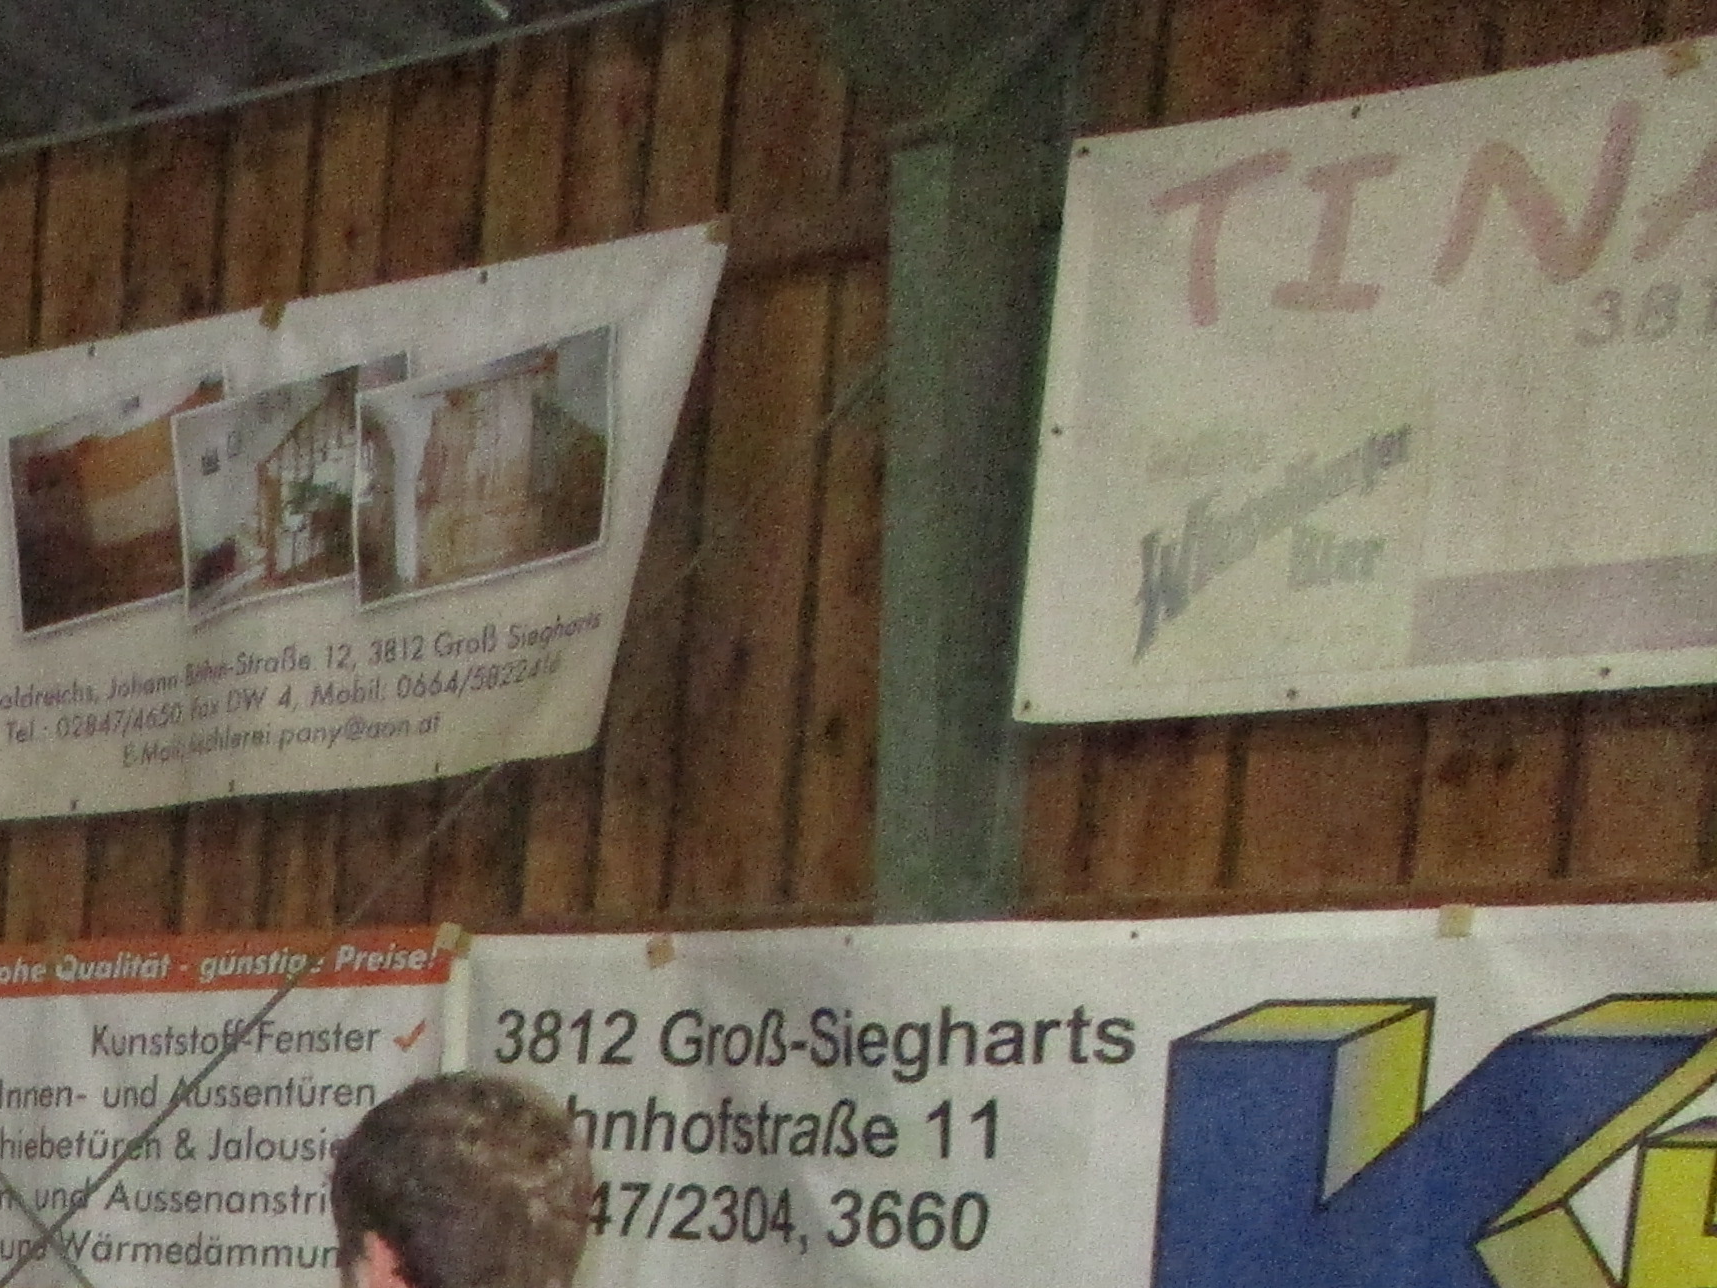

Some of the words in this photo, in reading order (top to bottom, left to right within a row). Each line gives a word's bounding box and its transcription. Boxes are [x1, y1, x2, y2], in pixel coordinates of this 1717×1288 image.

[368, 632, 425, 666] 3812
[432, 622, 498, 658] Groß
[55, 950, 172, 983] Qualität
[333, 945, 439, 972] Preise!
[90, 1017, 381, 1057] Kunststoff-Fenster
[494, 1006, 638, 1066] 3812
[657, 1003, 1138, 1085] Groß-Siegharts
[102, 1074, 158, 1108] und
[172, 1075, 376, 1109] Aussentüren
[174, 1128, 196, 1161] &
[925, 1097, 1001, 1161] 11
[35, 1176, 91, 1210] und
[104, 1180, 329, 1216] Aussenanstri
[827, 1188, 990, 1253] 3660
[56, 1229, 341, 1271] Wärmedämmun
